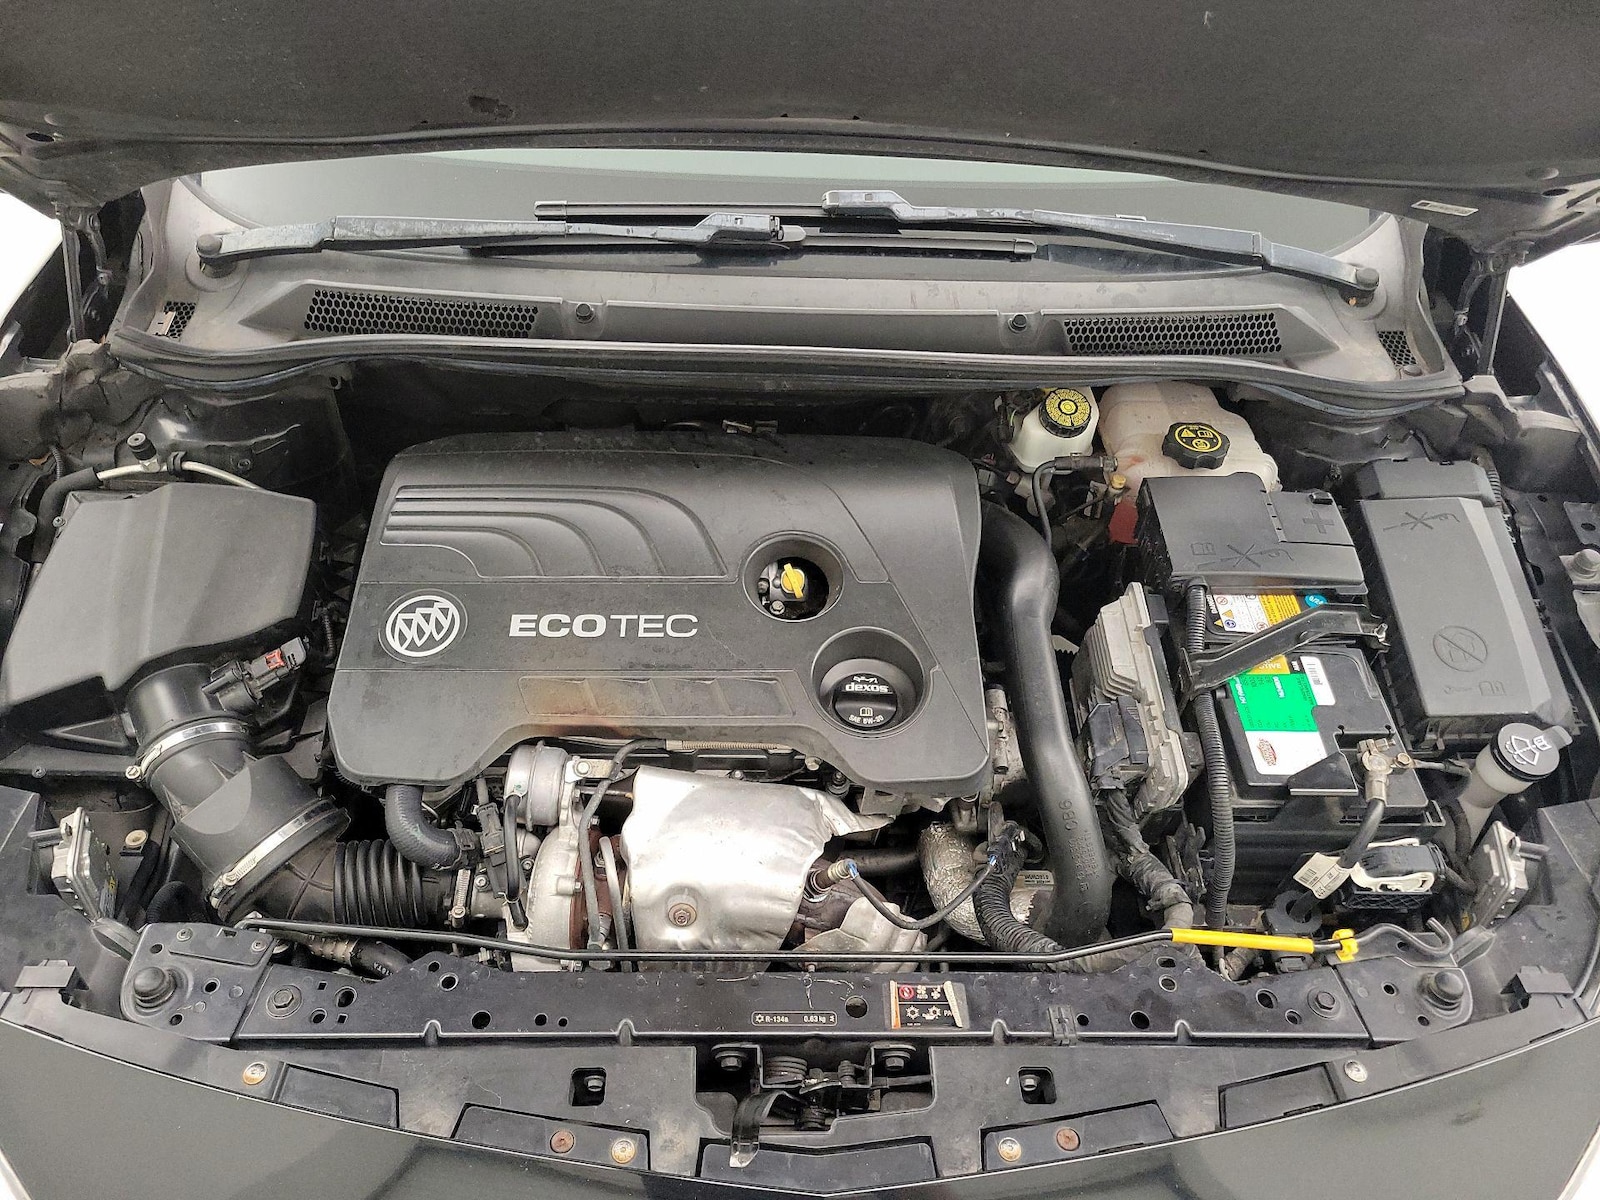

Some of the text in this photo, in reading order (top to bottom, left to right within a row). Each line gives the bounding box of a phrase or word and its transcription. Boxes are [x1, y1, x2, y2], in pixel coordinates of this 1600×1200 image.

[508, 613, 699, 639] ECOTEC
[845, 682, 889, 693] dexos
[765, 1015, 789, 1023] R-134a
